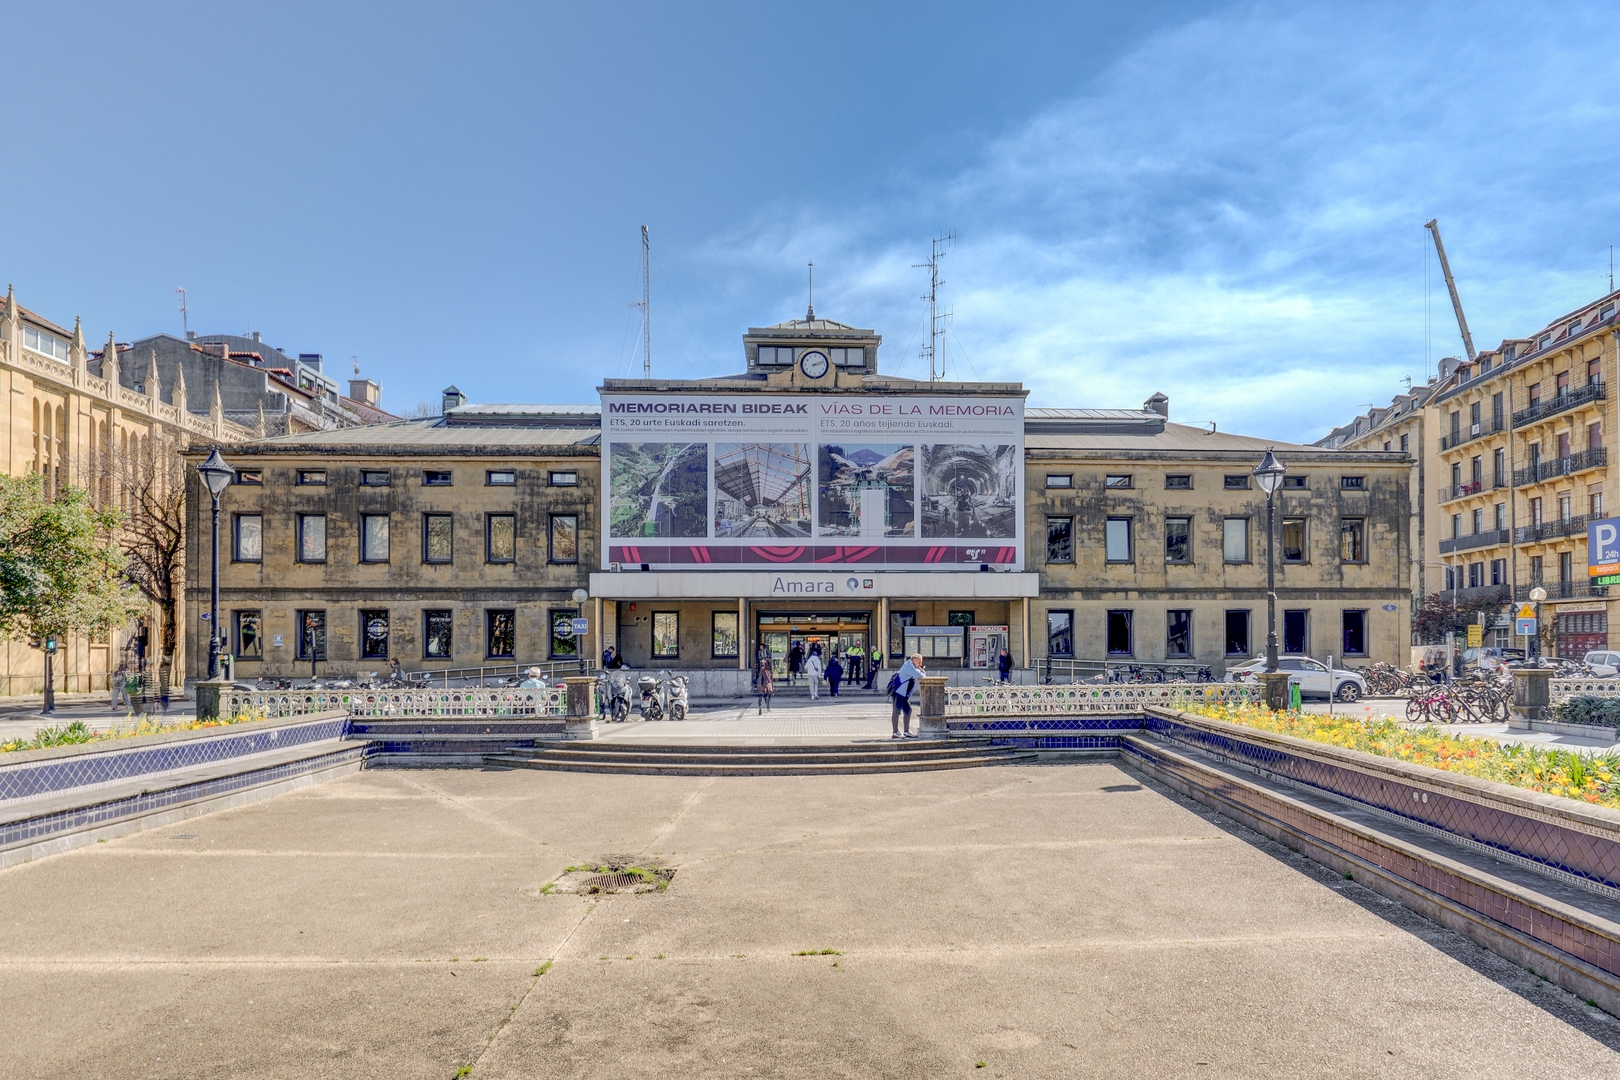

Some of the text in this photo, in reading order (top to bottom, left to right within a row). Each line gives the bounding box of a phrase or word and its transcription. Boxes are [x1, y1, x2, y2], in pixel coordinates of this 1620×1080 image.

[609, 403, 808, 414] MEMORIAREN BIDEAK
[820, 402, 1015, 416] VÍAS DE LA MEMORIA
[610, 418, 628, 427] ETS,
[820, 420, 838, 428] ETS,
[879, 420, 915, 429] tejiendo
[1596, 524, 1616, 560] P
[1605, 550, 1618, 559] 24h
[773, 577, 834, 592] Amara
